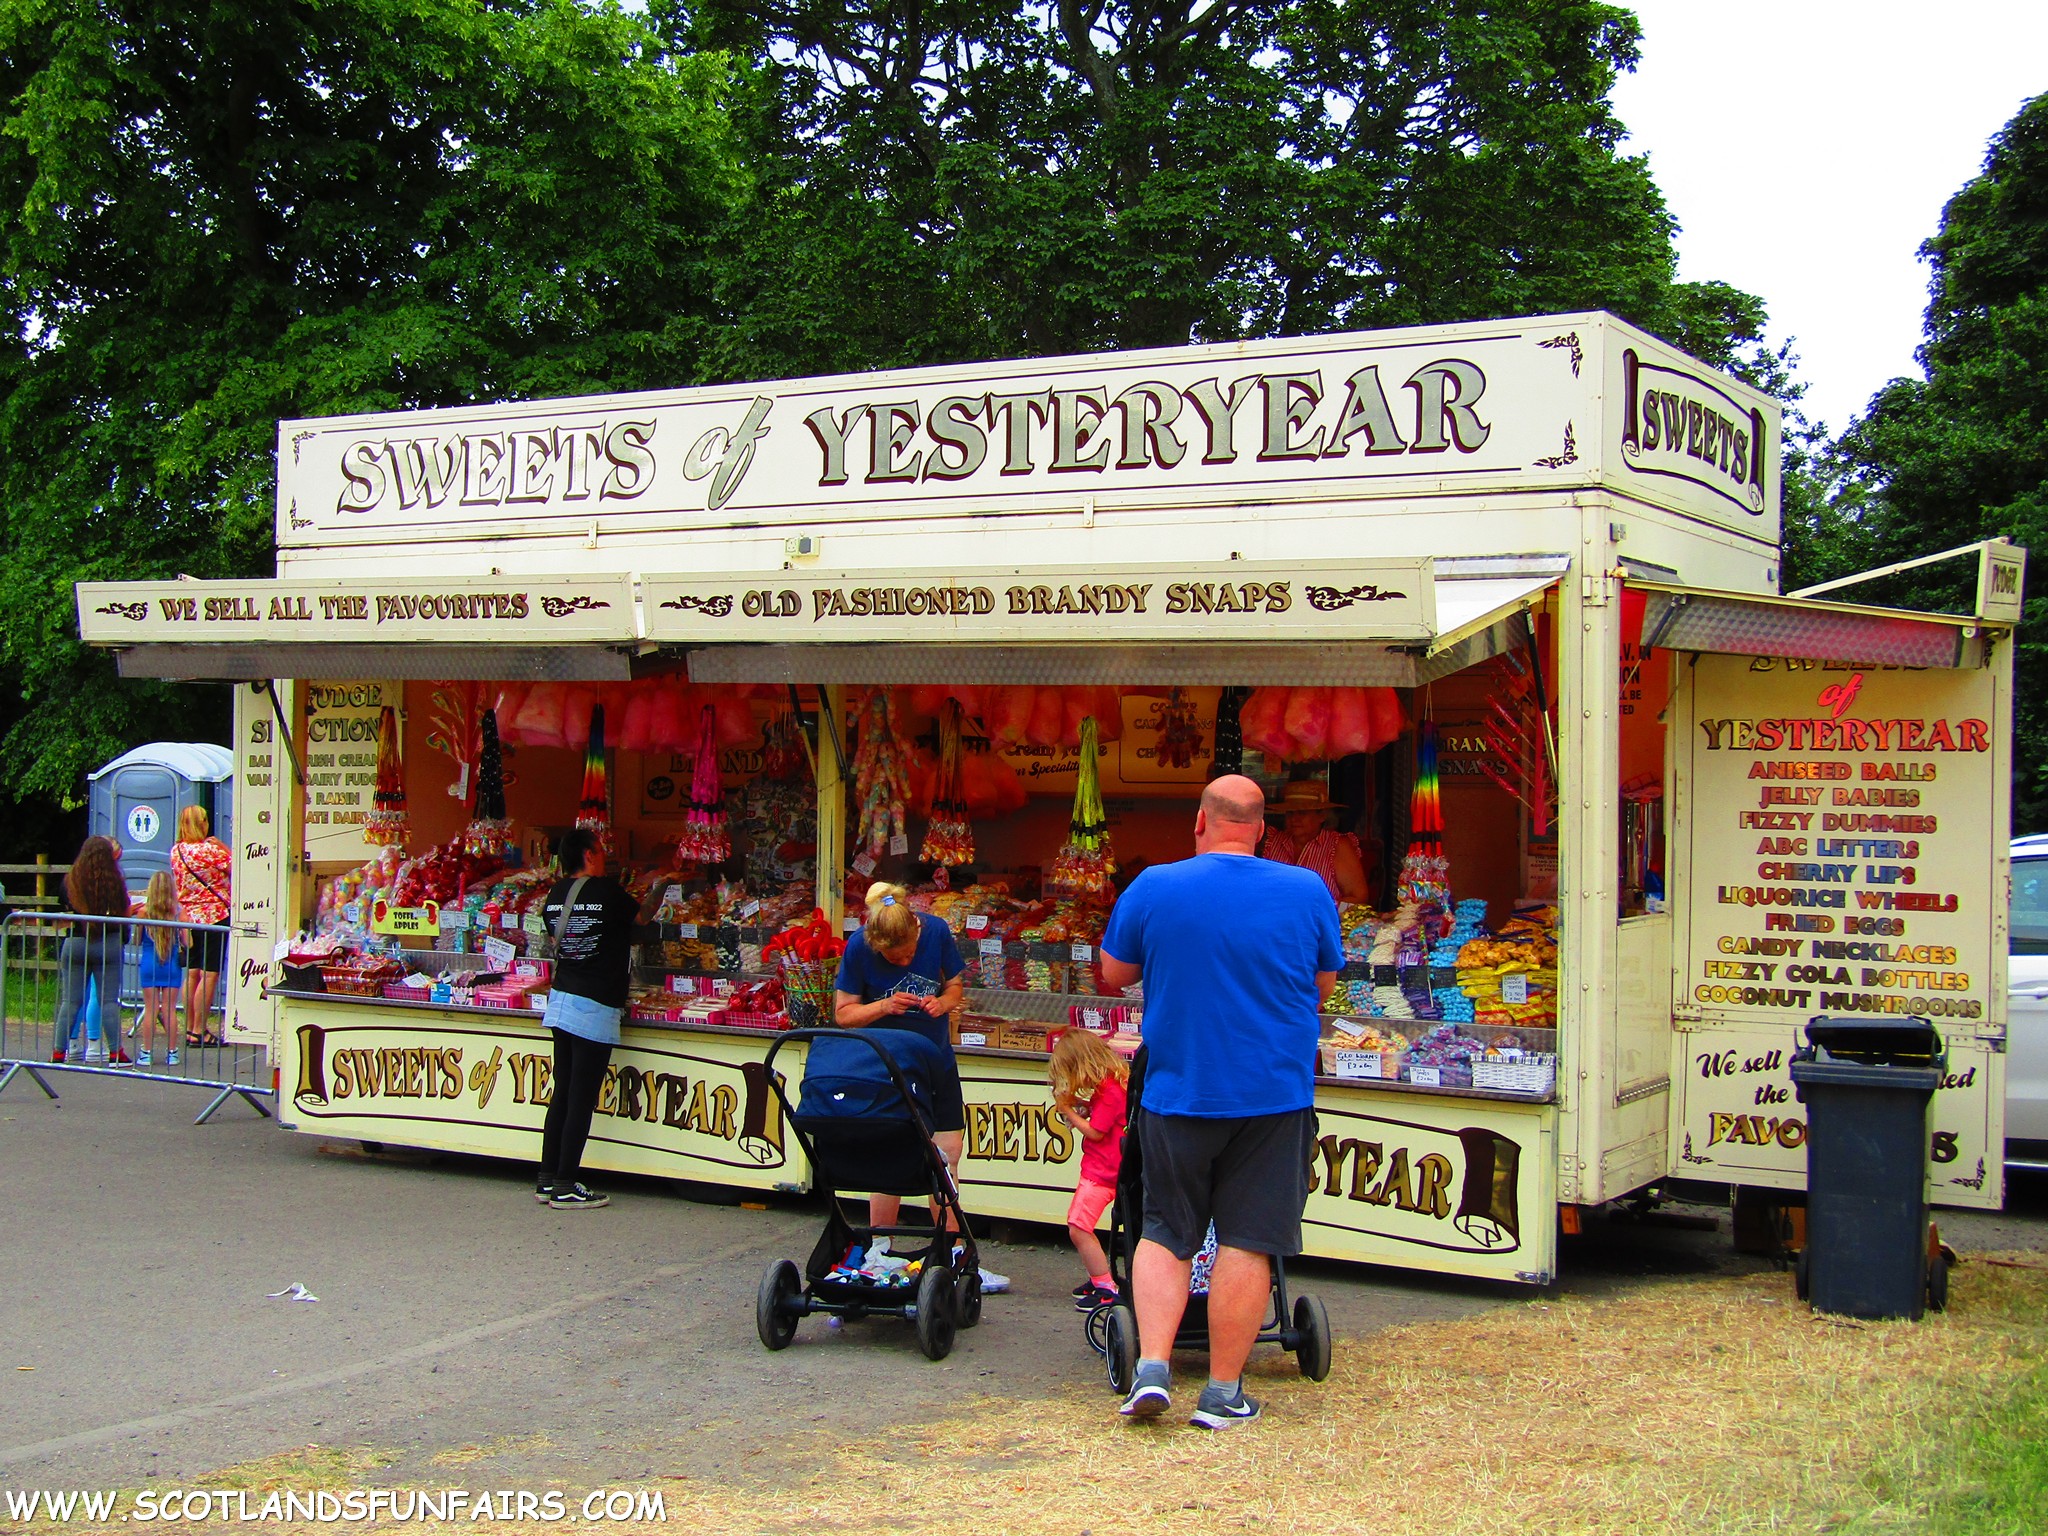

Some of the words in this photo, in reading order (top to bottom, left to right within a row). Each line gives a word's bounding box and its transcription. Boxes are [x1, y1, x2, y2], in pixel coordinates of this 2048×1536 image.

[337, 417, 658, 515] SWEETS
[683, 395, 774, 511] of
[803, 357, 1491, 486] YESTERYEAR
[1641, 387, 1749, 484] SWEETS
[159, 597, 199, 622] WE
[204, 597, 261, 622] SELL
[267, 597, 312, 621] ALL
[319, 596, 369, 620] THE
[376, 592, 531, 625] FAVOURITES
[740, 588, 802, 618] OLD
[813, 585, 996, 622] FASHIONED
[1007, 582, 1153, 617] BRANDY
[1165, 580, 1294, 615] SNAPS
[1817, 672, 1863, 719] of
[251, 717, 379, 744] SCTION
[1700, 718, 1990, 752] YESTERYEAR
[306, 754, 334, 767] RISH
[1747, 761, 1852, 781] ANISEED
[1861, 762, 1937, 782] BALLS
[316, 792, 360, 805] RAISIN
[1759, 786, 1824, 809] JELLY
[1832, 787, 1920, 808] BABIES
[1739, 811, 1814, 830] FIZZY
[1822, 813, 1938, 834] DUMMIES
[246, 842, 269, 860] Take
[1756, 836, 1808, 856] ABC
[1816, 838, 1920, 860] LETTERS
[1757, 861, 1857, 883] CHERRY
[1866, 865, 1916, 885] LIPS
[586, 903, 603, 911] 2022
[1717, 885, 1846, 908] LIQUORICE
[1854, 890, 1959, 912] WHEELS
[394, 921, 419, 930] APPLES
[1765, 912, 1835, 933] FRIED
[1844, 916, 1905, 936] EGGS
[1717, 936, 1804, 957] CANDY
[1811, 940, 1957, 964] NECKLACES
[1704, 960, 1778, 981] FIZZY
[1785, 964, 1852, 985] COLA
[1861, 967, 1970, 991] BOTTLES
[1694, 984, 1812, 1008] COCONUT
[1819, 990, 1982, 1018] MUSHROOMS
[1696, 1049, 1737, 1078] We
[1740, 1049, 1782, 1073] sell
[332, 1045, 464, 1100] SWEETS
[469, 1045, 503, 1109] of
[507, 1052, 738, 1141] YEERYEAR
[1754, 1084, 1789, 1105] the
[962, 1101, 1075, 1164] EETS
